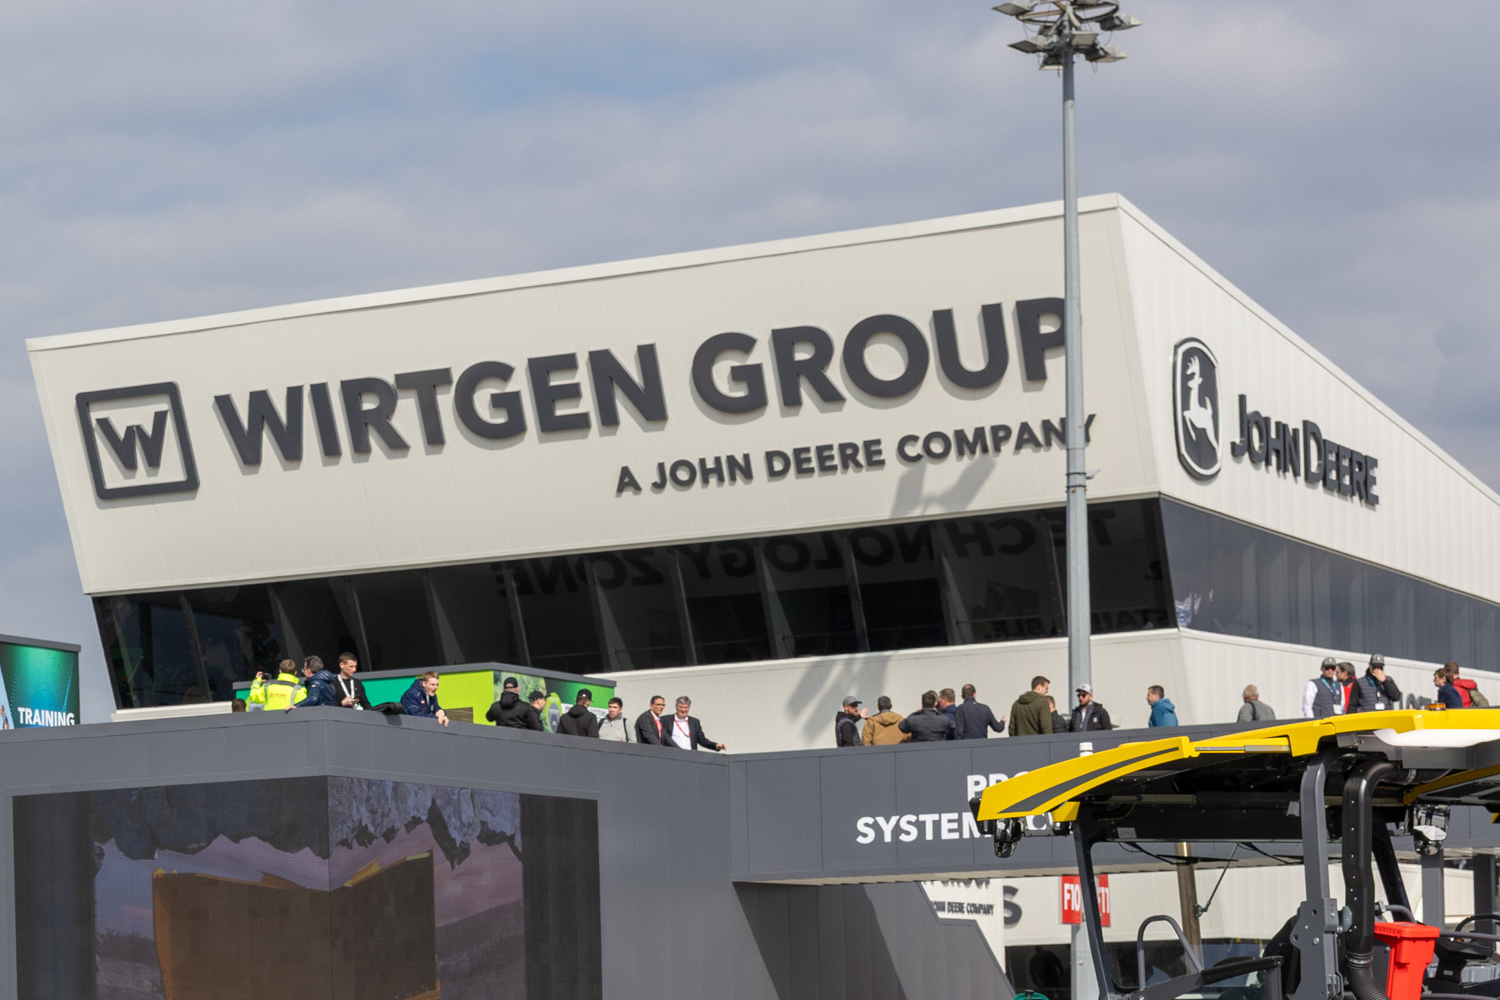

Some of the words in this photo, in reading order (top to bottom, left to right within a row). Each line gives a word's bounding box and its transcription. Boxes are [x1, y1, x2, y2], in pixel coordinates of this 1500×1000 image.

[213, 343, 668, 466] WIRTGEN
[691, 297, 1066, 414] GROUP
[615, 465, 642, 493] A
[651, 453, 754, 491] JOHN
[765, 438, 886, 479] DEERE
[1230, 394, 1301, 477] JOHN
[1302, 420, 1380, 506] DEERE
[17, 706, 75, 727] TRAINING
[1063, 882, 1081, 912] F10
[1098, 886, 1110, 914] 11
